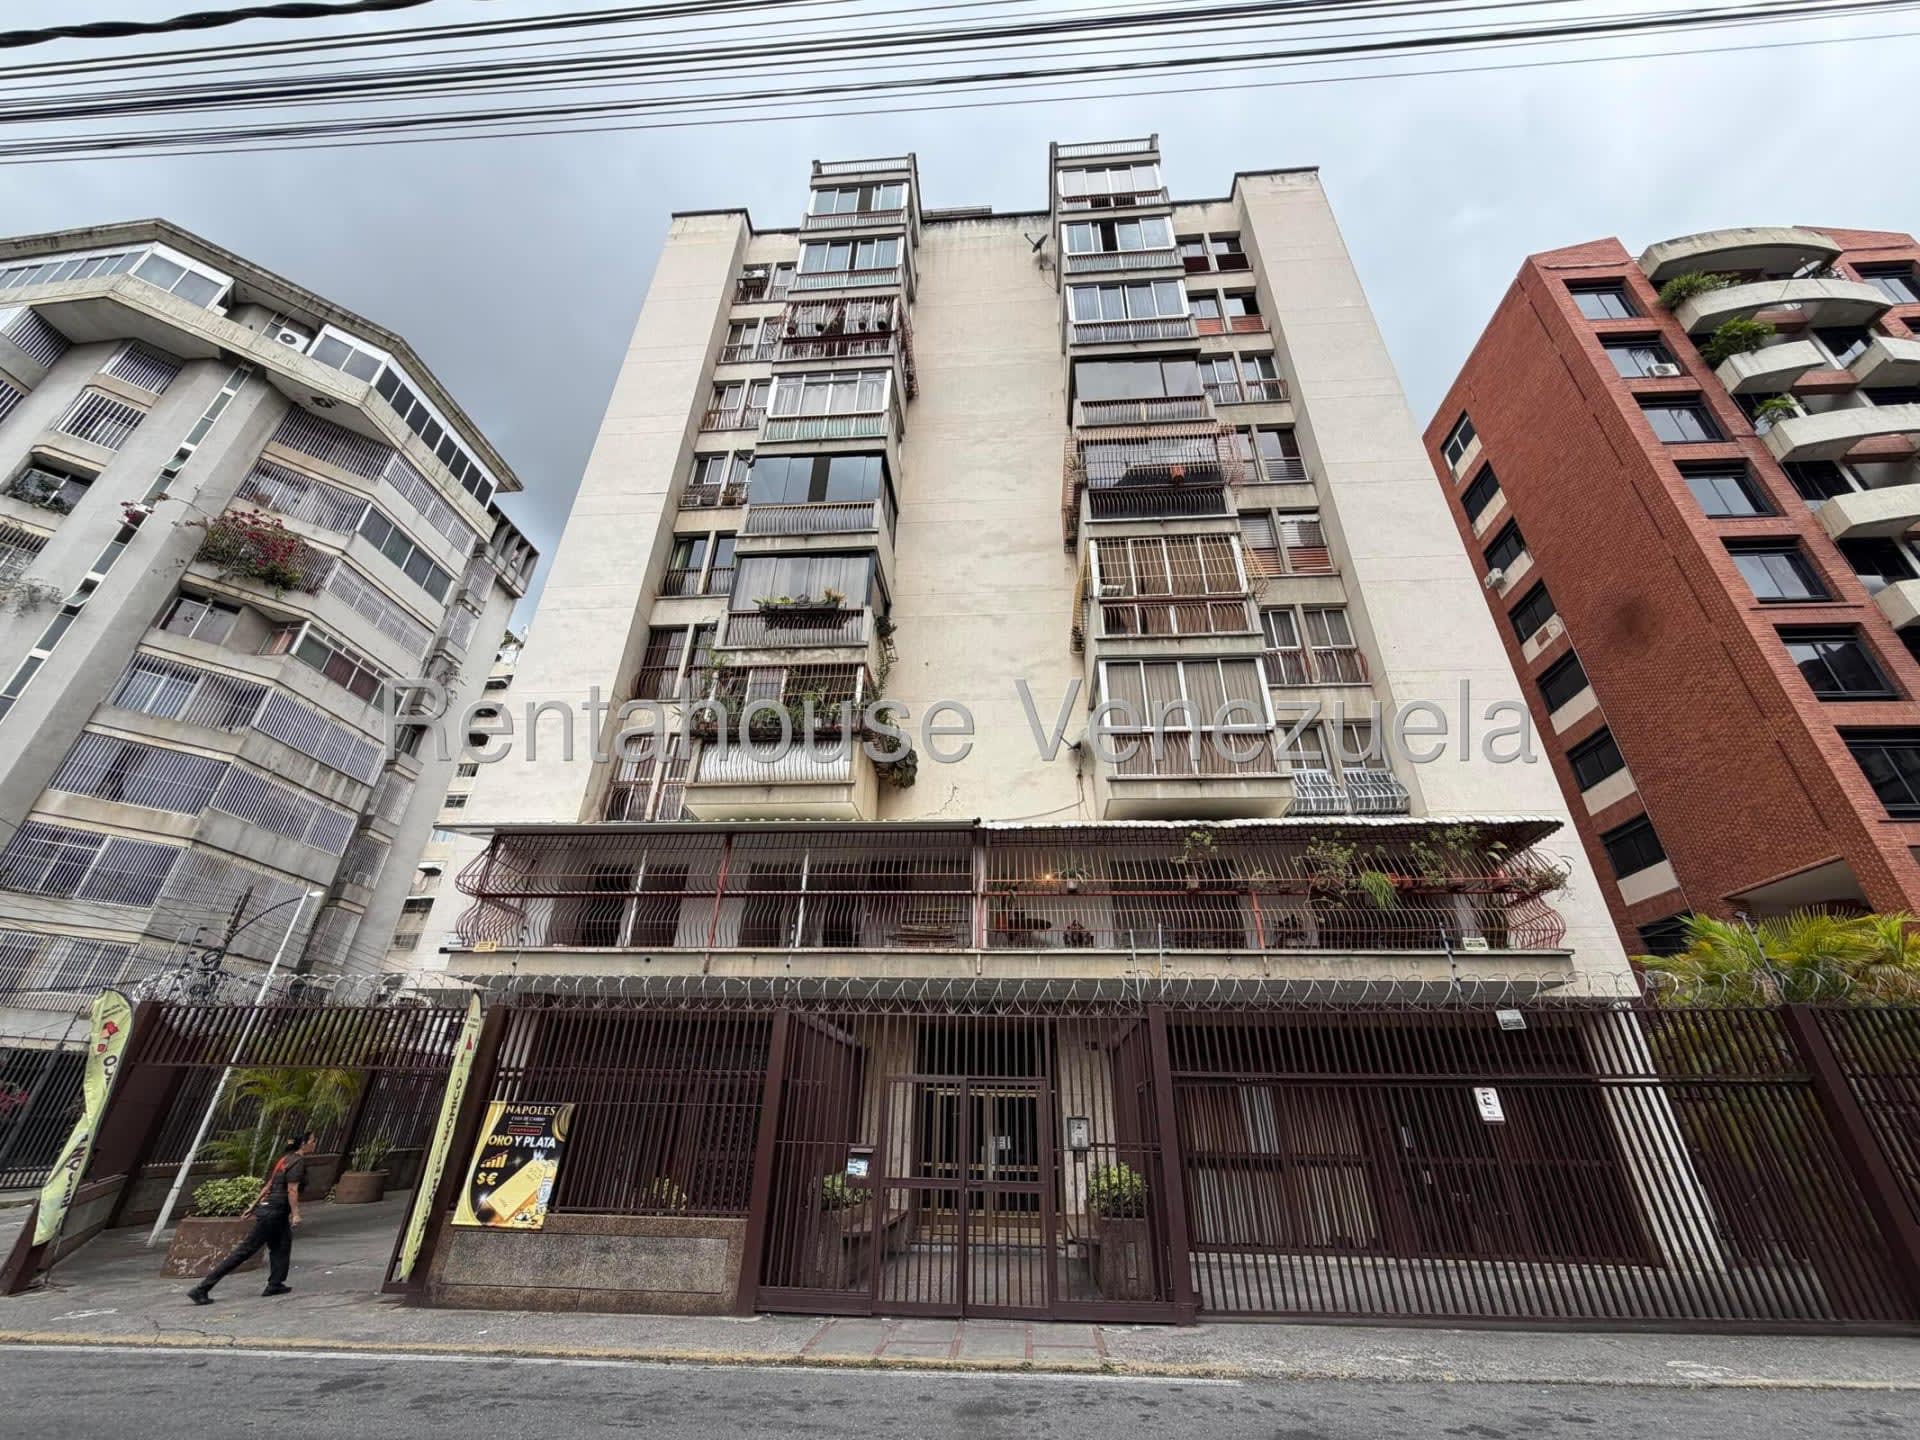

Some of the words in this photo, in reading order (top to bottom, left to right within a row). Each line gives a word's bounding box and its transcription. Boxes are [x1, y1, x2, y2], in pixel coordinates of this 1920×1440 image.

[488, 1134, 513, 1146] ORO
[514, 1135, 524, 1147] Y
[523, 1135, 556, 1149] PLATA
